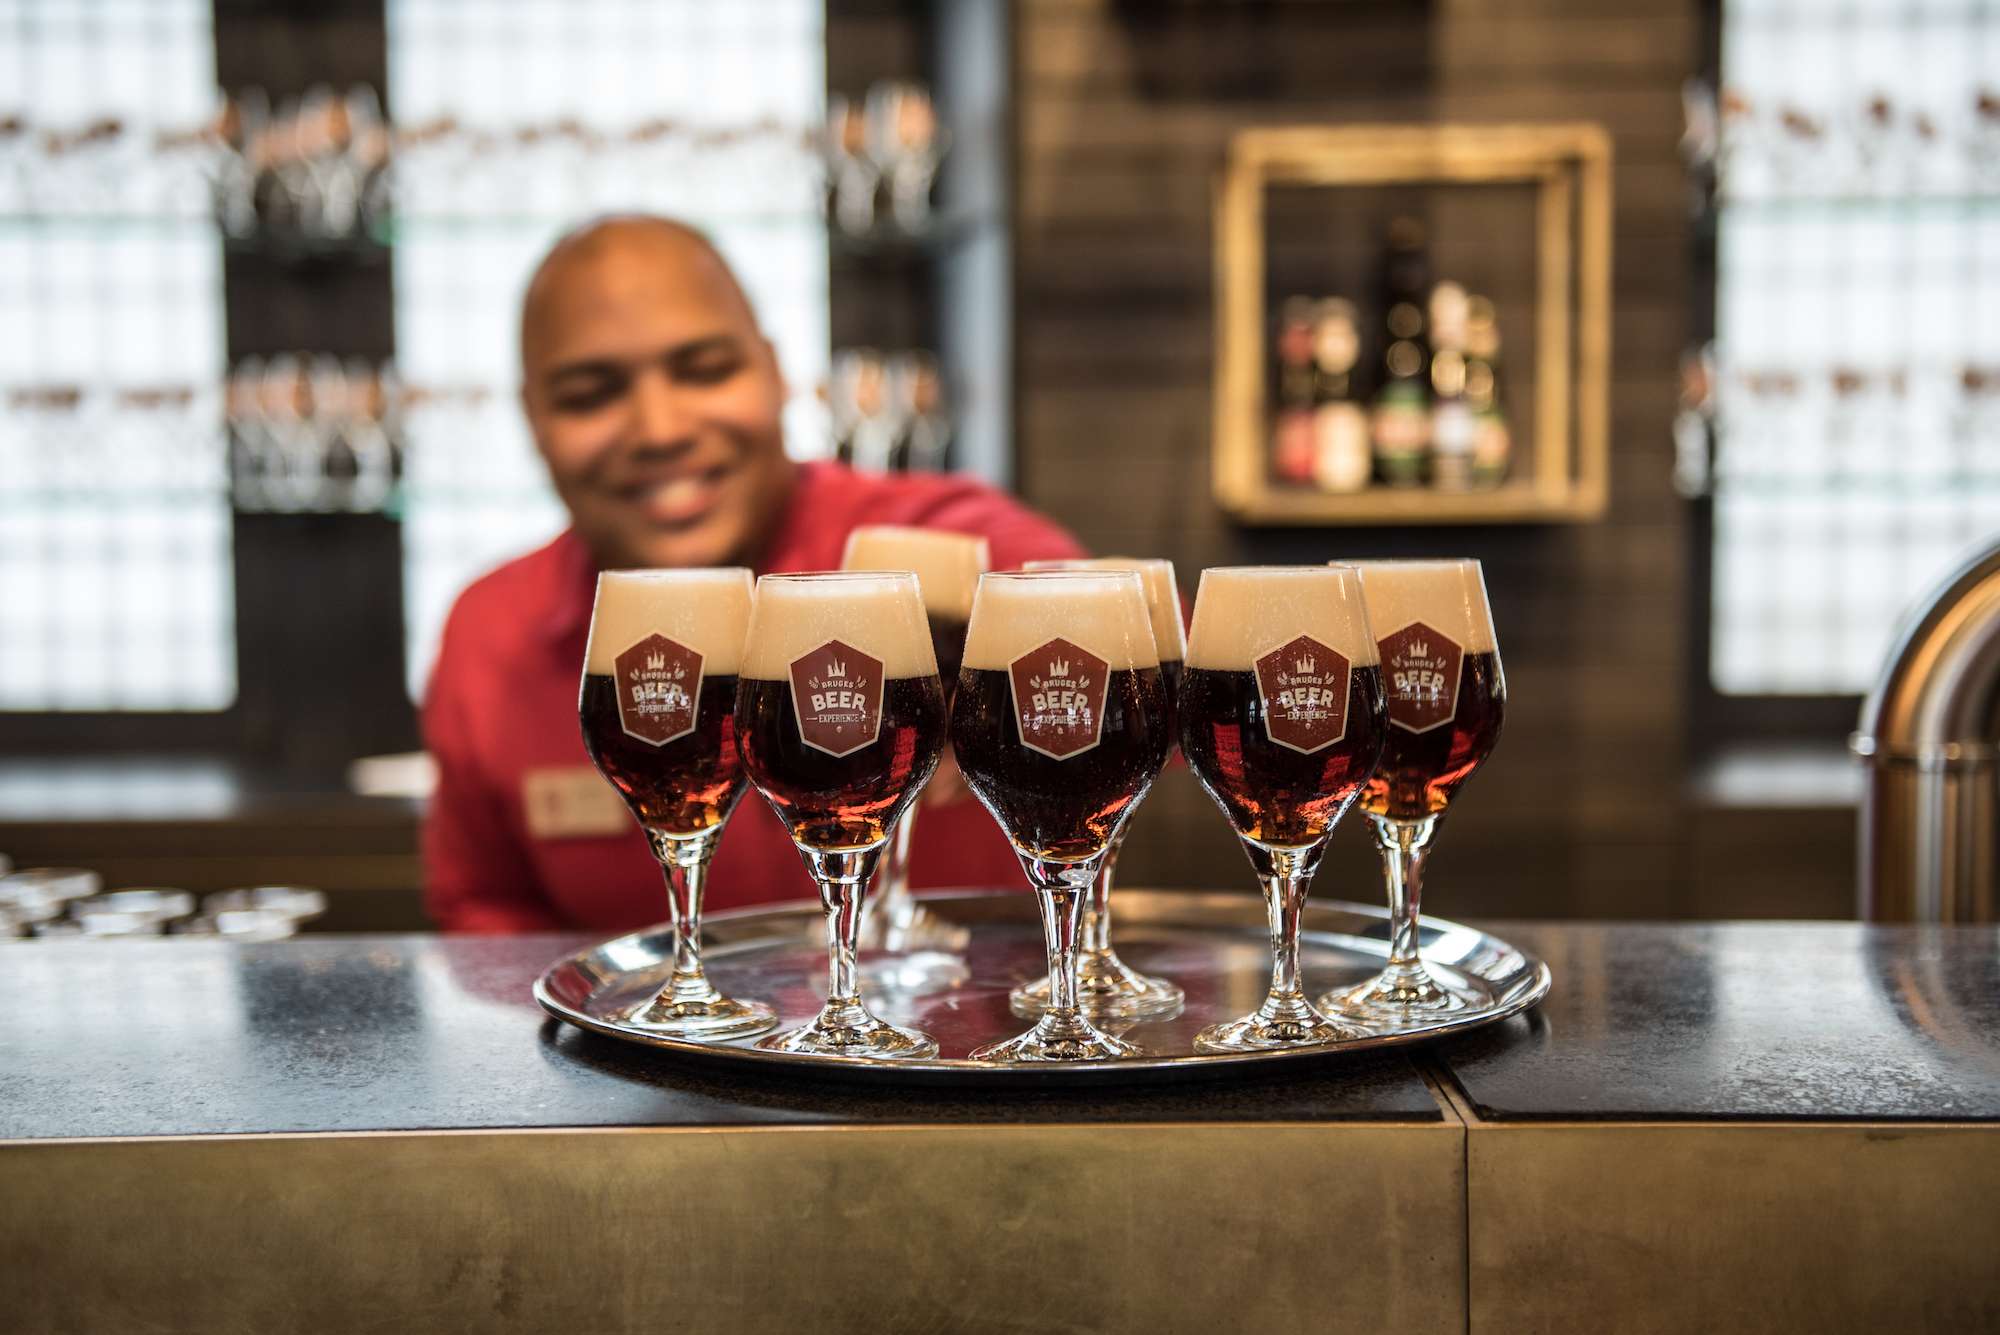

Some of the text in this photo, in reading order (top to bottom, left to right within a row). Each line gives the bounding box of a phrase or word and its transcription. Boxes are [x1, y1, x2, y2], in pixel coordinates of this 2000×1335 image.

[822, 680, 854, 689] BRUGES
[1394, 670, 1445, 691] BEER
[631, 682, 682, 703] BEER
[811, 691, 866, 712] BEER
[1032, 691, 1088, 713] BEER
[1279, 687, 1334, 709] BEER
[819, 714, 859, 723] EXPERIENCE
